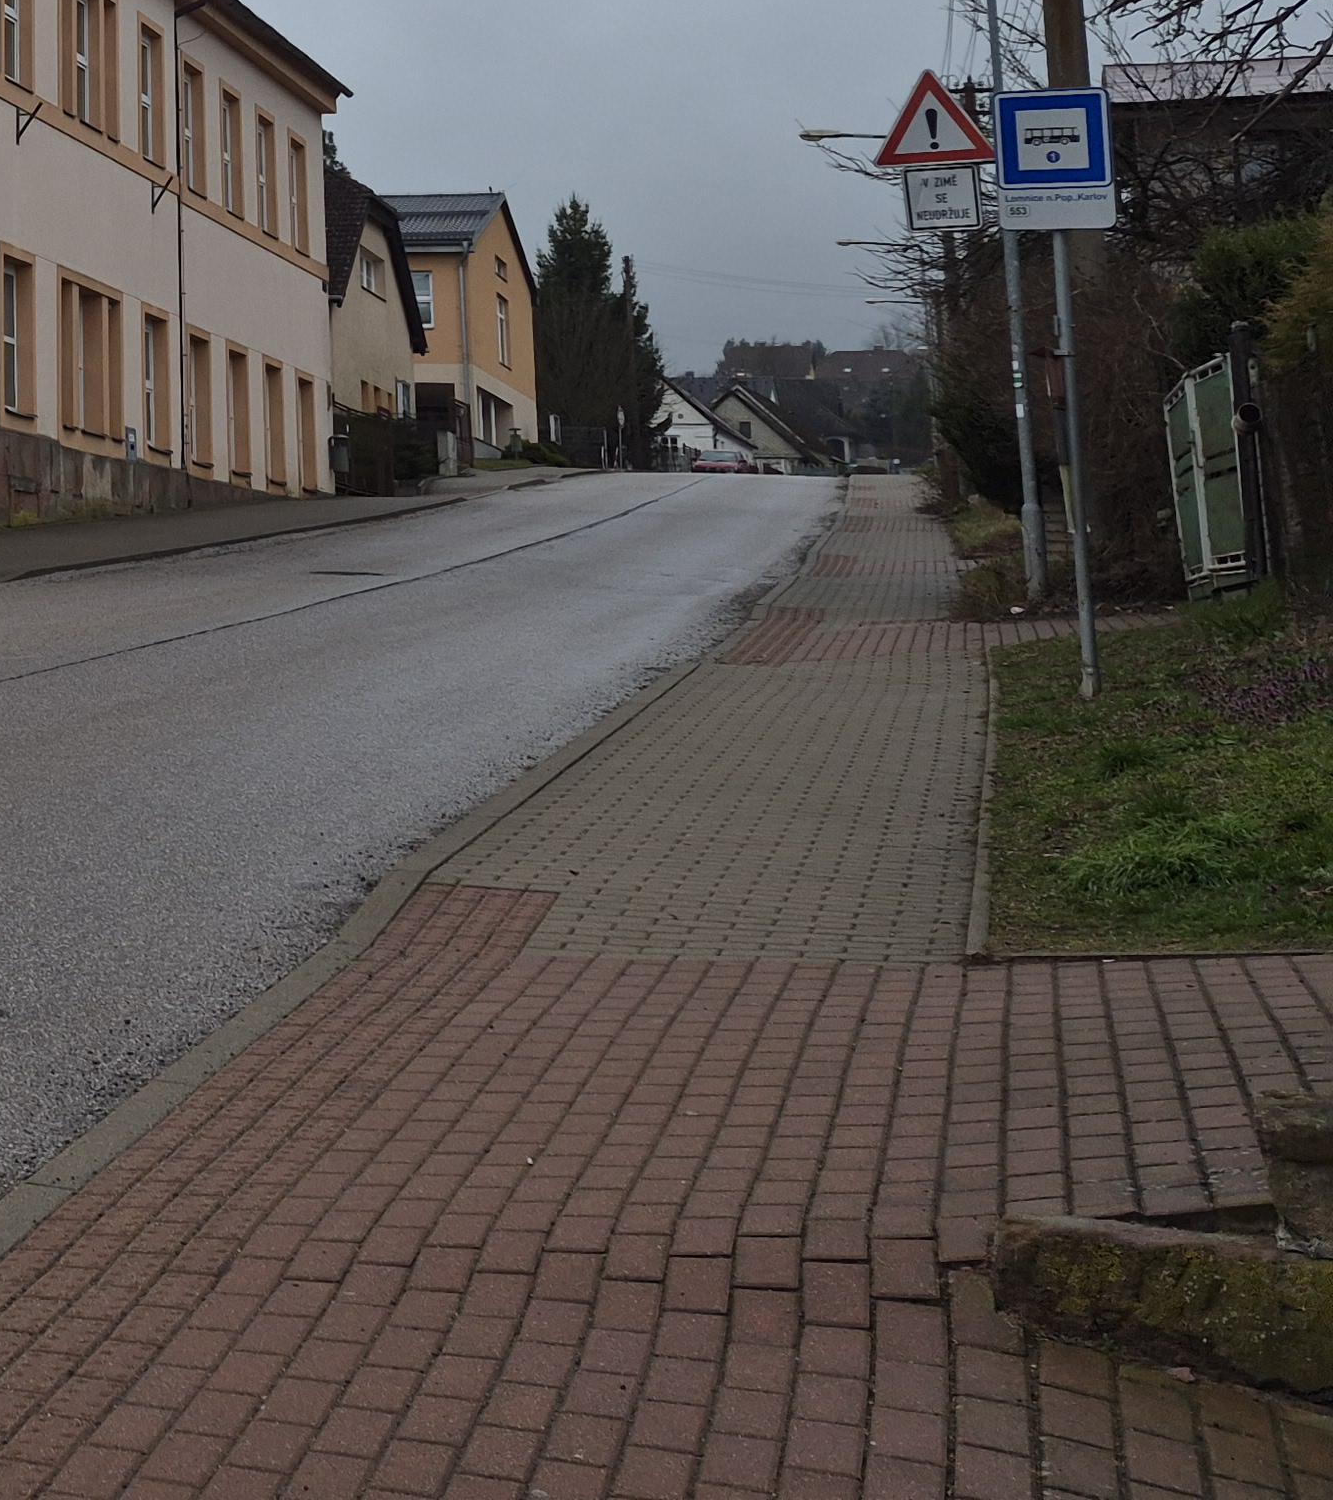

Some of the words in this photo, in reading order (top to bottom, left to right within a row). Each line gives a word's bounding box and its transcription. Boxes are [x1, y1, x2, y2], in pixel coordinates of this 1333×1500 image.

[921, 177, 929, 188] V
[935, 192, 949, 204] SE
[1005, 193, 1044, 203] Lomnice
[916, 207, 972, 221] NEUDRŽUJE
[1009, 206, 1028, 216] 553
